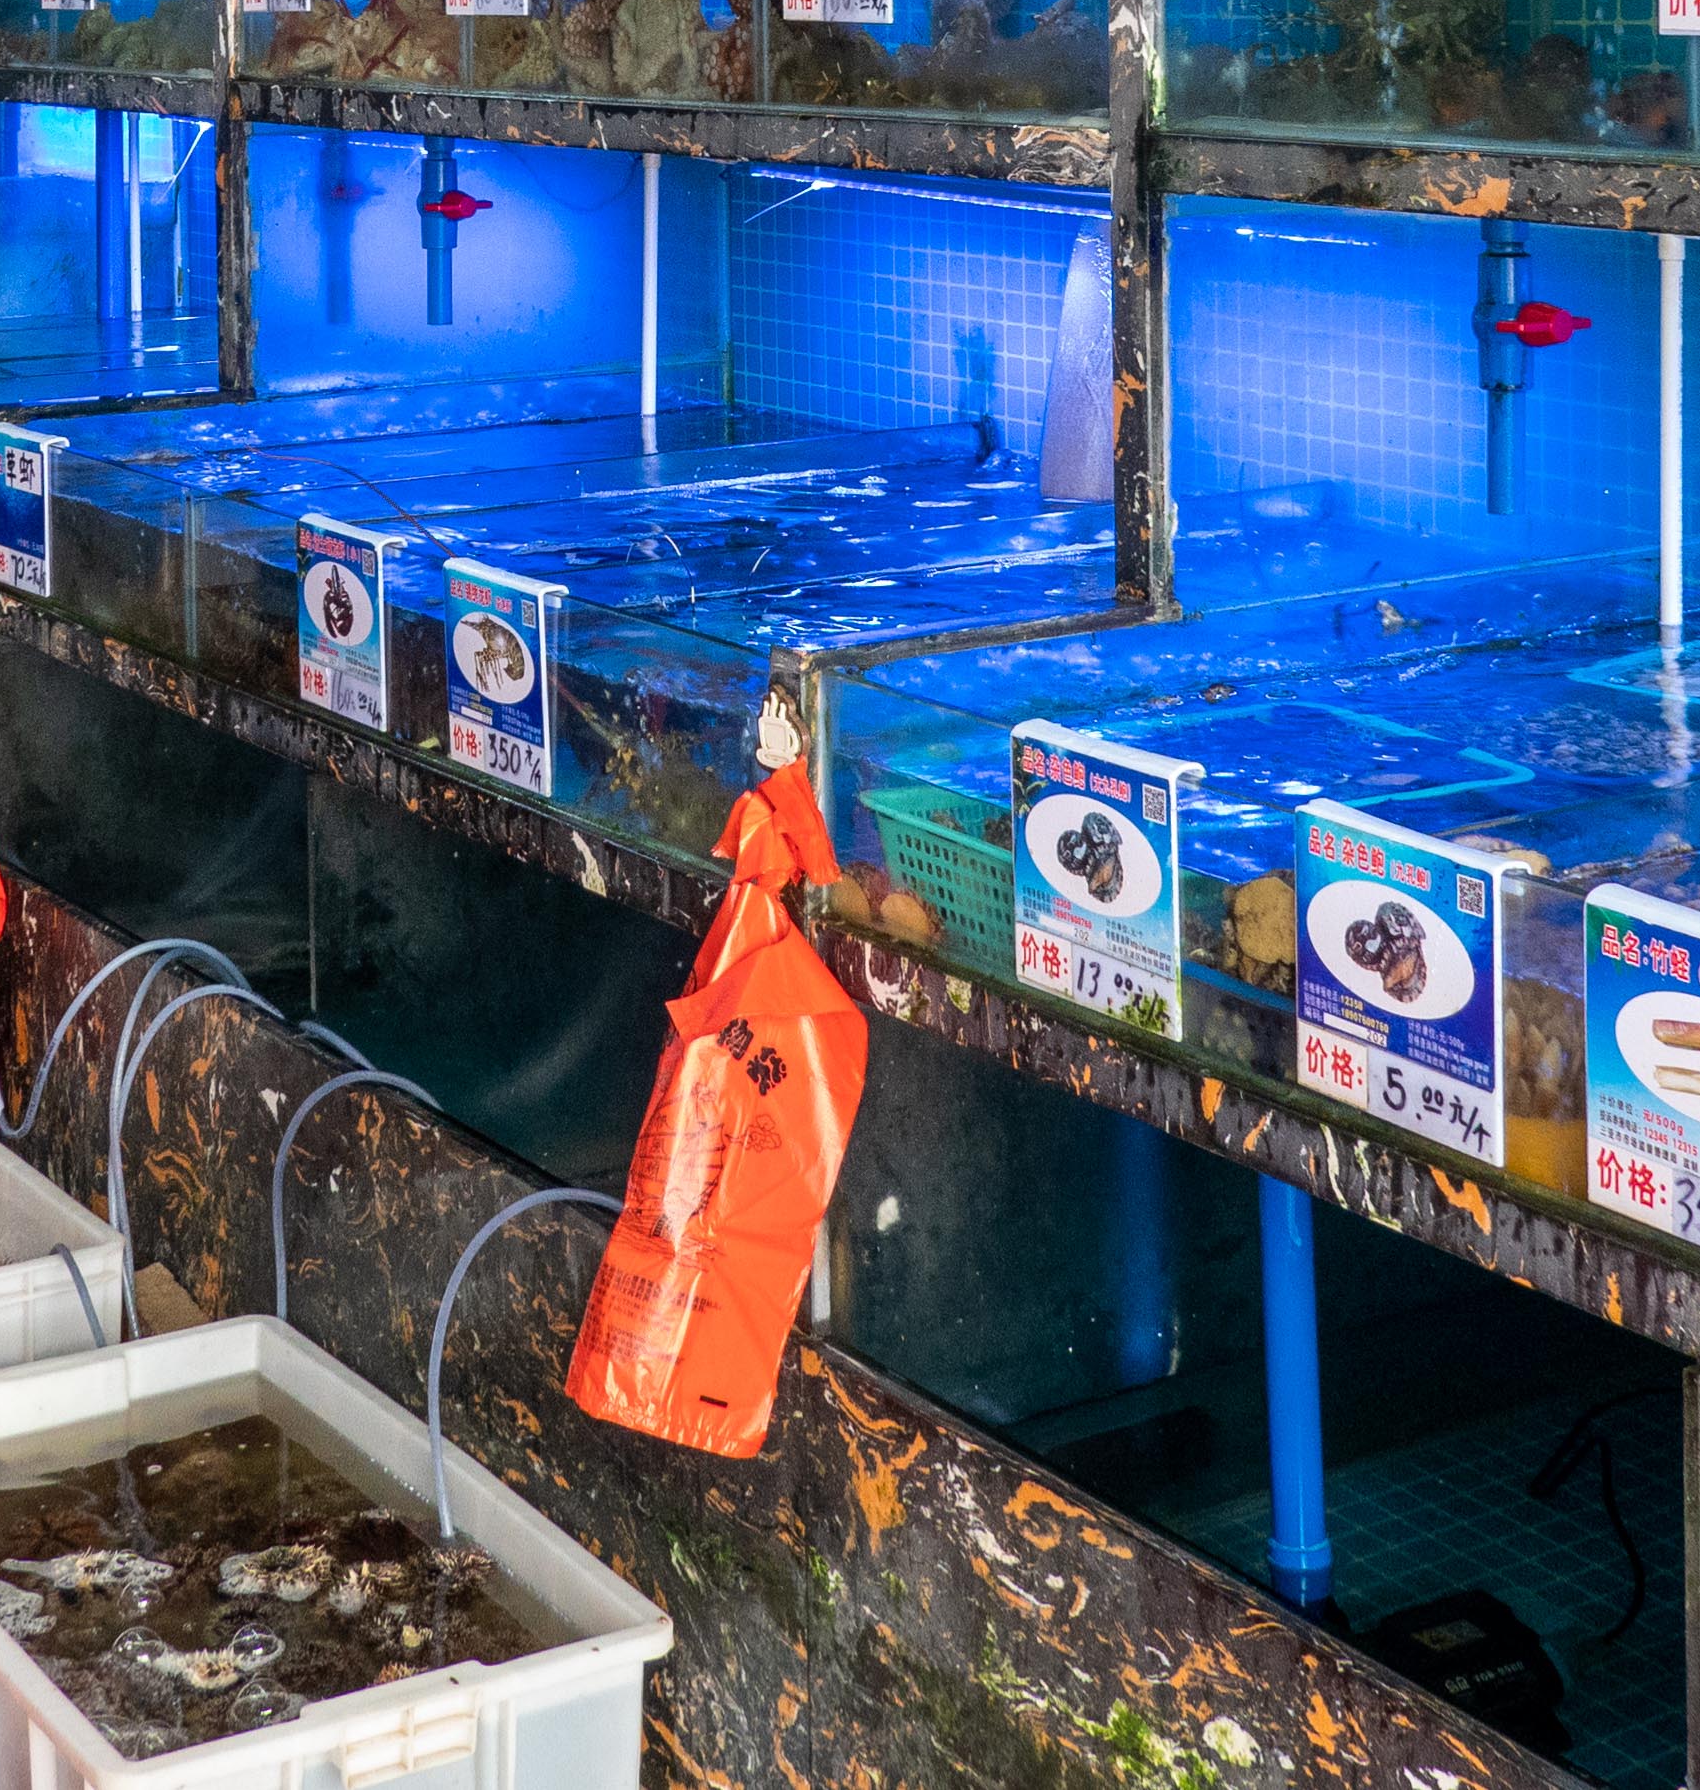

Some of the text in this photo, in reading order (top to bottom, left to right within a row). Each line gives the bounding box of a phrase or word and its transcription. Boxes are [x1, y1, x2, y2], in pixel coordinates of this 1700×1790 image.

[453, 724, 483, 759] 价格:
[1021, 931, 1068, 979] 价格:
[1601, 923, 1691, 983] 品名:竹蛏
[1305, 1035, 1364, 1091] 价格:
[1597, 1146, 1667, 1210] 价格:
